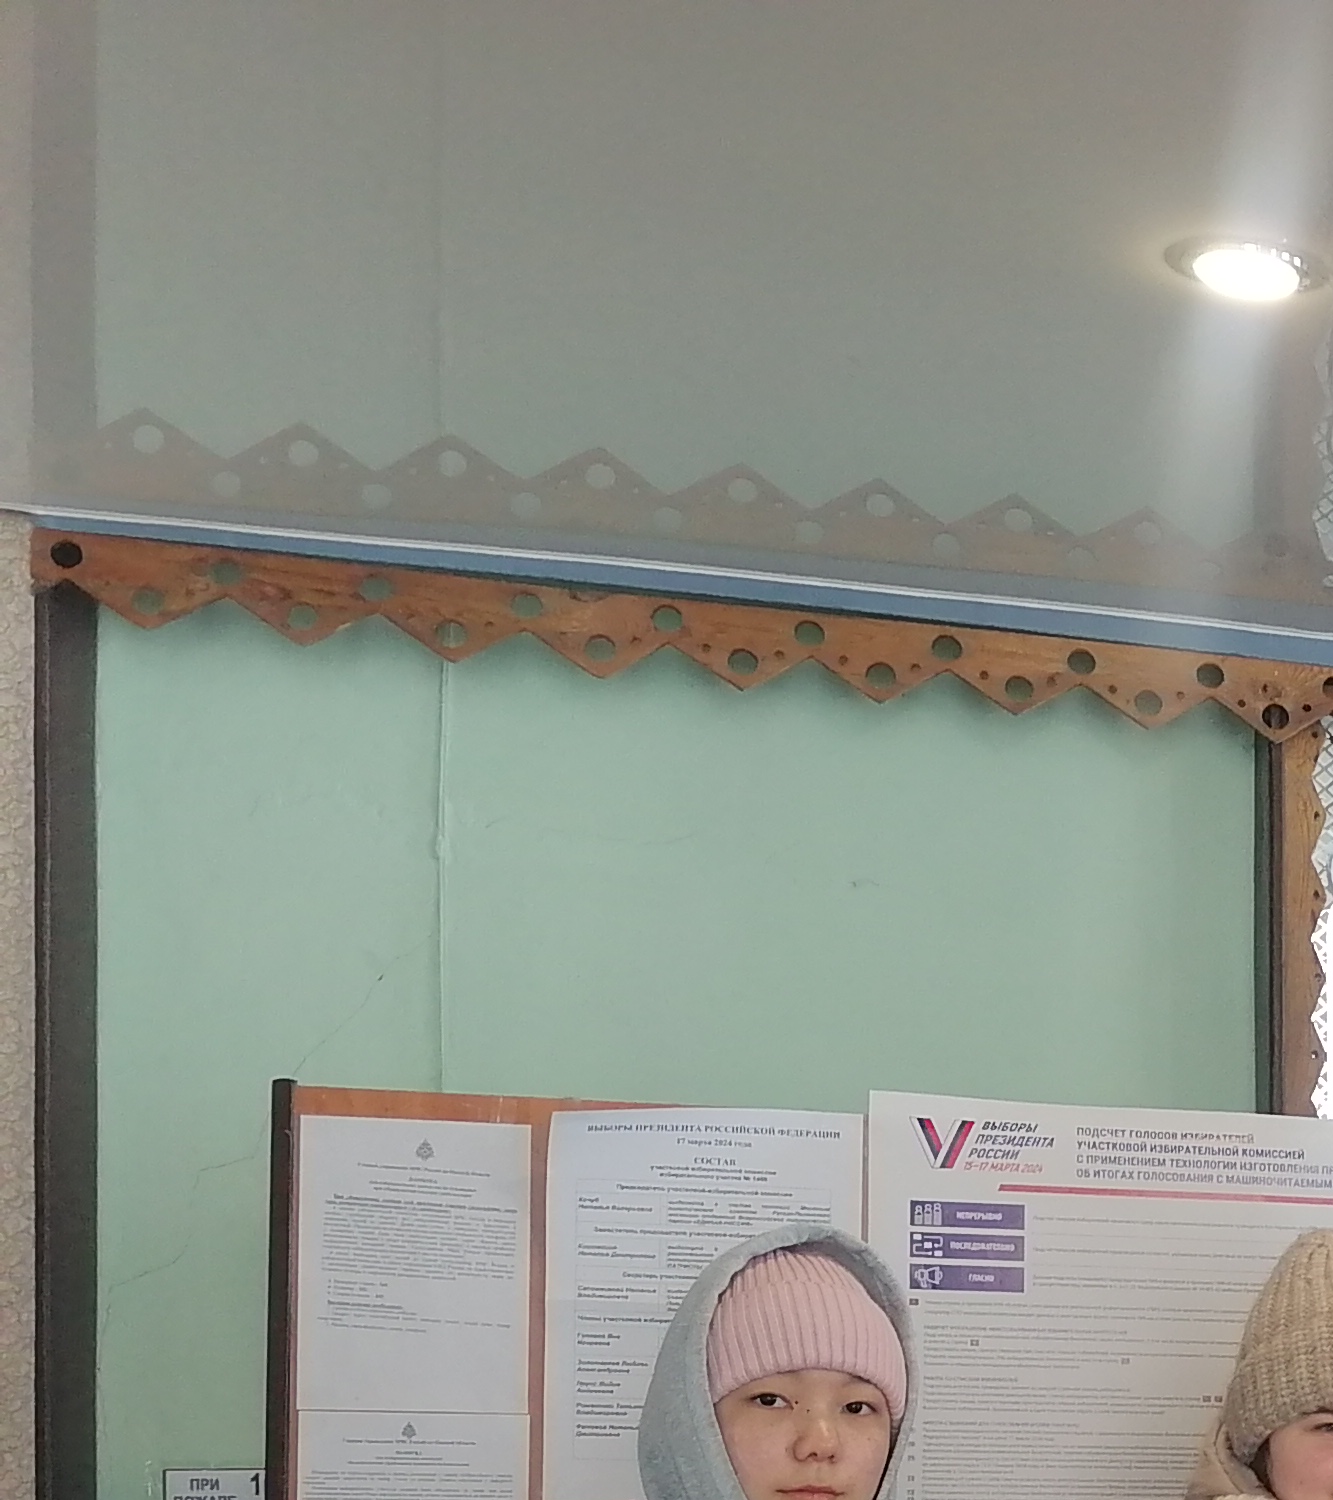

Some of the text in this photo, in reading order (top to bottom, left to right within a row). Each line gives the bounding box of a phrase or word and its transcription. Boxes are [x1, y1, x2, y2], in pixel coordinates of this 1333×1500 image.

[635, 1123, 702, 1133] ПРЕЗИДЕНТА
[704, 1124, 776, 1136] РОССИЙСКОЙ
[777, 1128, 841, 1140] ФЕДЕРАЦИИ
[981, 1120, 1039, 1134] ВЫБОРЫ
[974, 1134, 1056, 1149] ПРЕЗИДЕНТА
[1076, 1126, 1255, 1145] ПОДСЧЕТ ГОЛОСОВ ИЗБИРАТЕЛЕЙ
[968, 1147, 1021, 1161] РОССИИ
[1076, 1140, 1305, 1161] УЧАСТКОВОЙ ИЗБИРАТЕЛЬНОЙ КОМИССИЕЙ
[693, 1157, 737, 1167] СОСТАВ
[990, 1162, 1021, 1172] МАРТА
[1021, 1163, 1043, 1173] 2024
[1076, 1154, 1084, 1164] С
[1086, 1154, 1167, 1168] ПРИМЕНЕНИЕМ
[1168, 1157, 1238, 1171] ТЕХНОЛОГИИ
[1239, 1161, 1320, 1174] ИЗГОТОВЛЕНИЯ
[1076, 1168, 1091, 1179] ОБ
[1093, 1169, 1135, 1181] ИТОГАХ
[1137, 1170, 1214, 1184] ГОЛОСОВАНИЯ
[1216, 1175, 1224, 1185] С
[1225, 1174, 1333, 1189] МАШИНОЧИТАЕМЫМ
[189, 1477, 220, 1491] ПРИ
